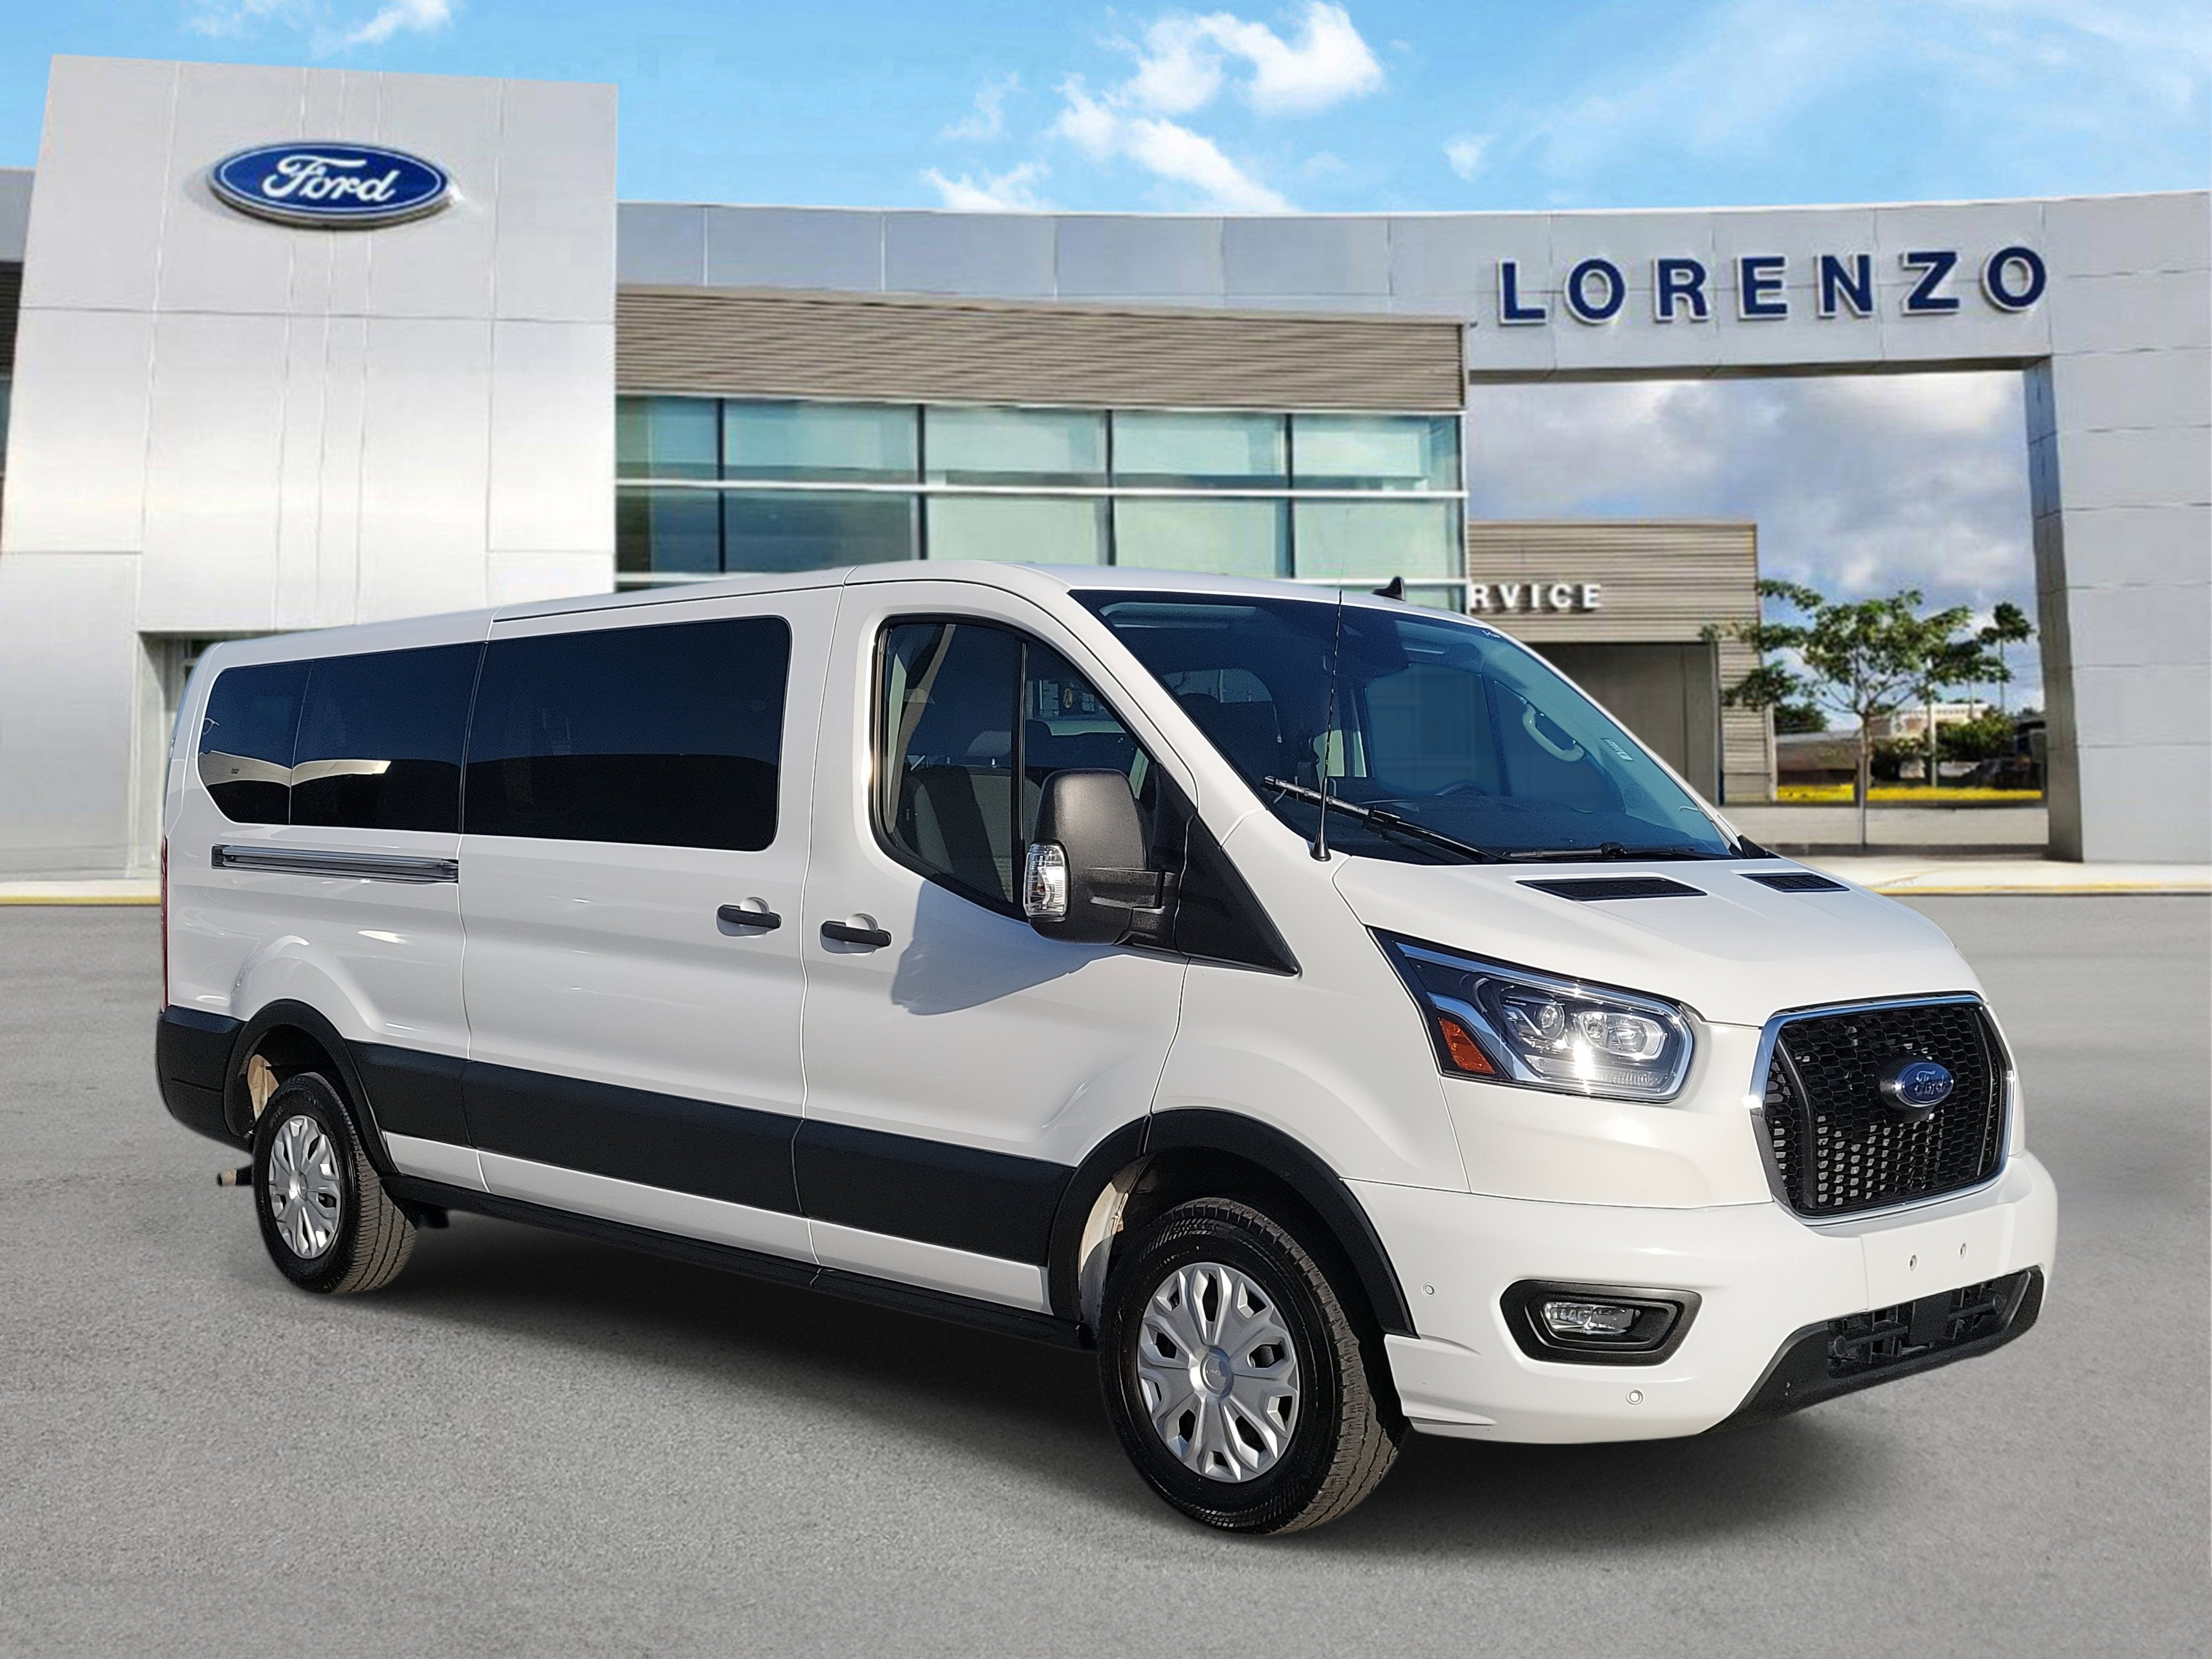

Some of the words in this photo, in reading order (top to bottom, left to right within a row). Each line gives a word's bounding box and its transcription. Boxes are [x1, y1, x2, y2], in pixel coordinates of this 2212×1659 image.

[262, 154, 400, 202] Ford
[1499, 245, 2047, 324] LORENZO
[1469, 584, 1602, 609] RVICE
[1914, 1070, 1947, 1097] Ford
